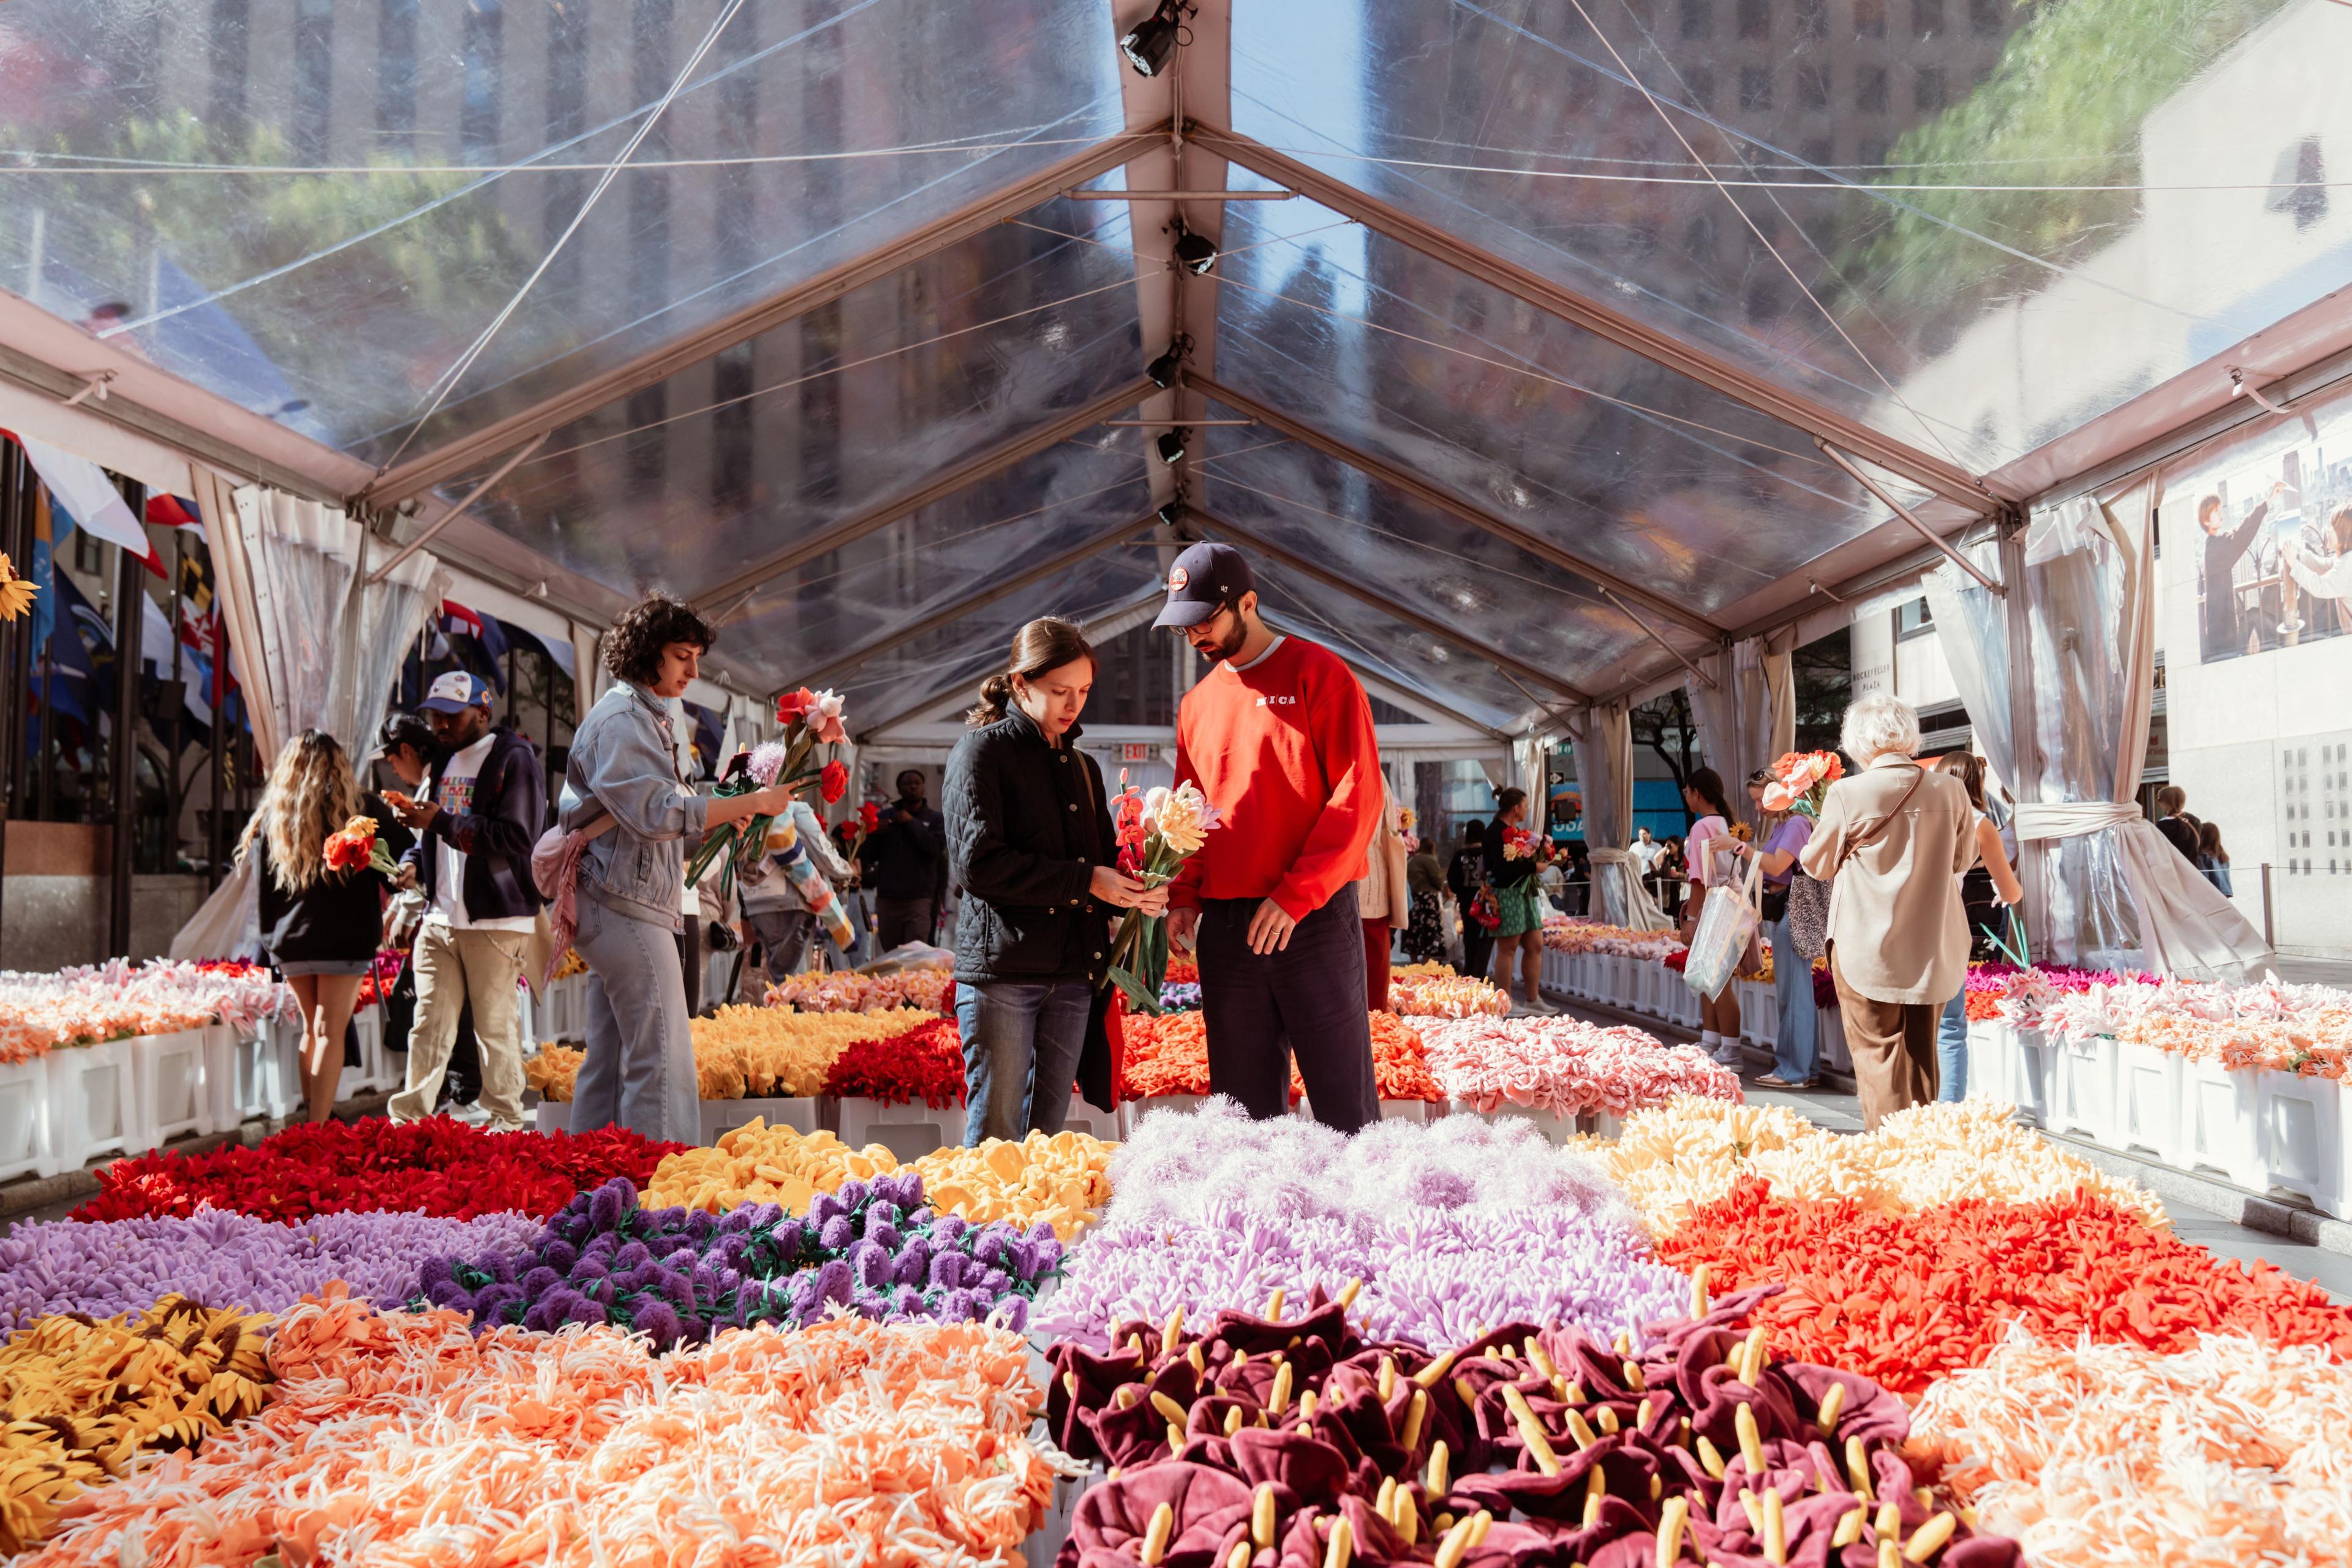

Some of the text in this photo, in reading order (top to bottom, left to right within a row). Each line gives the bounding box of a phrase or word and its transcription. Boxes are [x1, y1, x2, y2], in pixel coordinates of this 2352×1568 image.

[1853, 665, 1890, 681] ROCKEFELLER
[1863, 681, 1880, 691] PLAZA
[1126, 744, 1147, 760] EXIT
